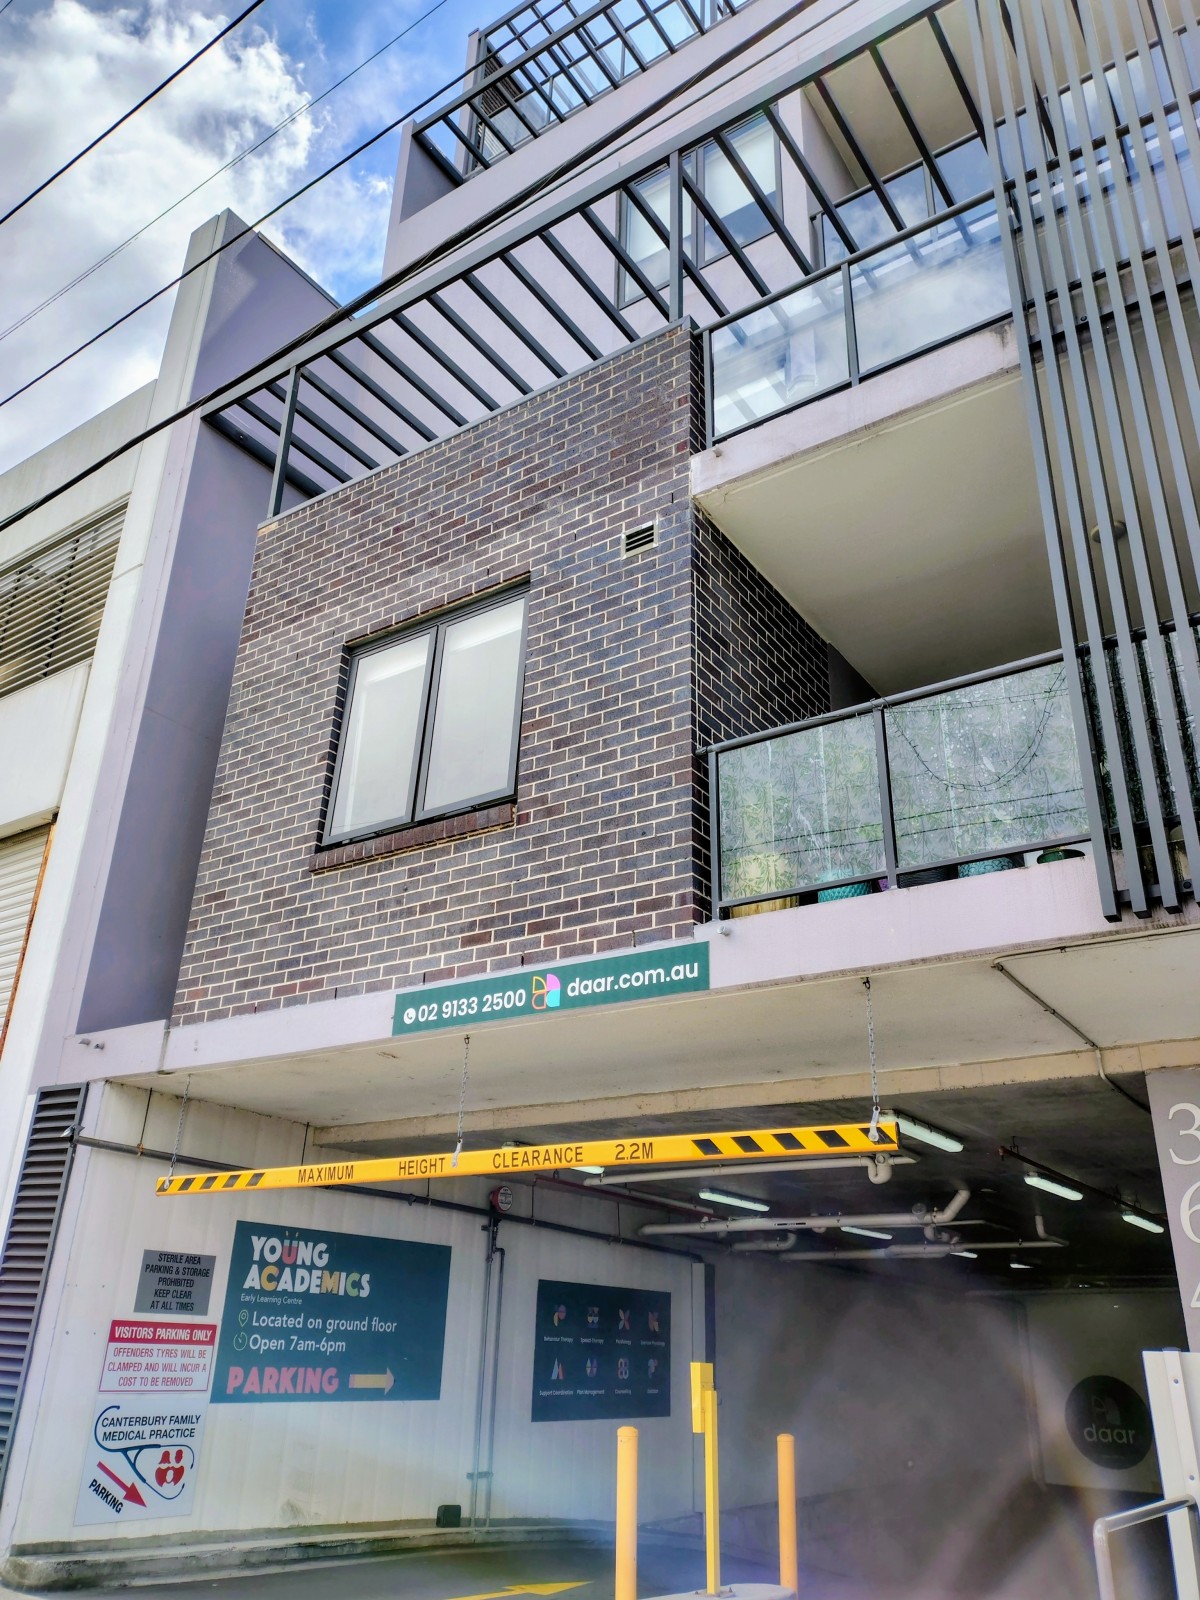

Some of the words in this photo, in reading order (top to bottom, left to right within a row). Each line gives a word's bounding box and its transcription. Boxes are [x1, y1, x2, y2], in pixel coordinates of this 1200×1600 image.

[567, 961, 698, 998] daar.com.au
[418, 1003, 438, 1023] 02
[441, 996, 478, 1019] 9133
[482, 988, 526, 1013] 2500
[297, 1164, 355, 1185] MAXIMUM
[398, 1157, 445, 1177] HEIGHT
[492, 1146, 584, 1169] CLEARANCE
[614, 1142, 655, 1161] 2.2M
[250, 1234, 329, 1268] YOUNG
[157, 1253, 184, 1264] STERILE
[185, 1255, 201, 1265] AREA
[145, 1264, 174, 1275] PARKING
[174, 1267, 180, 1276] &
[181, 1266, 211, 1278] STORAGE
[157, 1277, 195, 1288] PROHIBITED
[243, 1263, 371, 1298] ACADEMICS
[153, 1288, 170, 1298] KEEP
[171, 1289, 192, 1300] CLEAR
[240, 1293, 256, 1304] Early
[256, 1294, 282, 1306] Learning
[282, 1296, 303, 1305] Centre
[150, 1300, 159, 1310] AT
[160, 1300, 173, 1311] ALL
[174, 1301, 194, 1312] TIMES
[252, 1311, 304, 1329] Located
[307, 1318, 322, 1329] on
[326, 1317, 368, 1333] ground
[371, 1316, 398, 1332] floor
[114, 1326, 153, 1339] VISITORS
[155, 1328, 191, 1341] PARKING
[192, 1329, 213, 1342] ONLY
[249, 1334, 285, 1354] Open
[290, 1335, 346, 1356] 7am-6pm
[113, 1347, 154, 1358] OFFENDERS
[155, 1348, 179, 1359] TYRES
[180, 1349, 196, 1359] WILL
[198, 1349, 207, 1359] BE
[107, 1361, 142, 1372] CLAMPED
[143, 1362, 160, 1373] AND
[161, 1363, 178, 1373] WILL
[179, 1363, 200, 1373] INCUR
[201, 1363, 207, 1373] A
[118, 1376, 137, 1387] COST
[139, 1377, 149, 1387] TO
[150, 1377, 160, 1387] BE
[161, 1377, 193, 1387] REMOVED
[226, 1366, 340, 1395] PARKING
[101, 1415, 168, 1428] CANTERBURY
[168, 1414, 201, 1426] FAMILY
[102, 1430, 147, 1442] MEDICAL
[149, 1428, 196, 1439] PRACTICE
[1083, 1423, 1136, 1444] daar
[88, 1478, 124, 1515] PARKING
